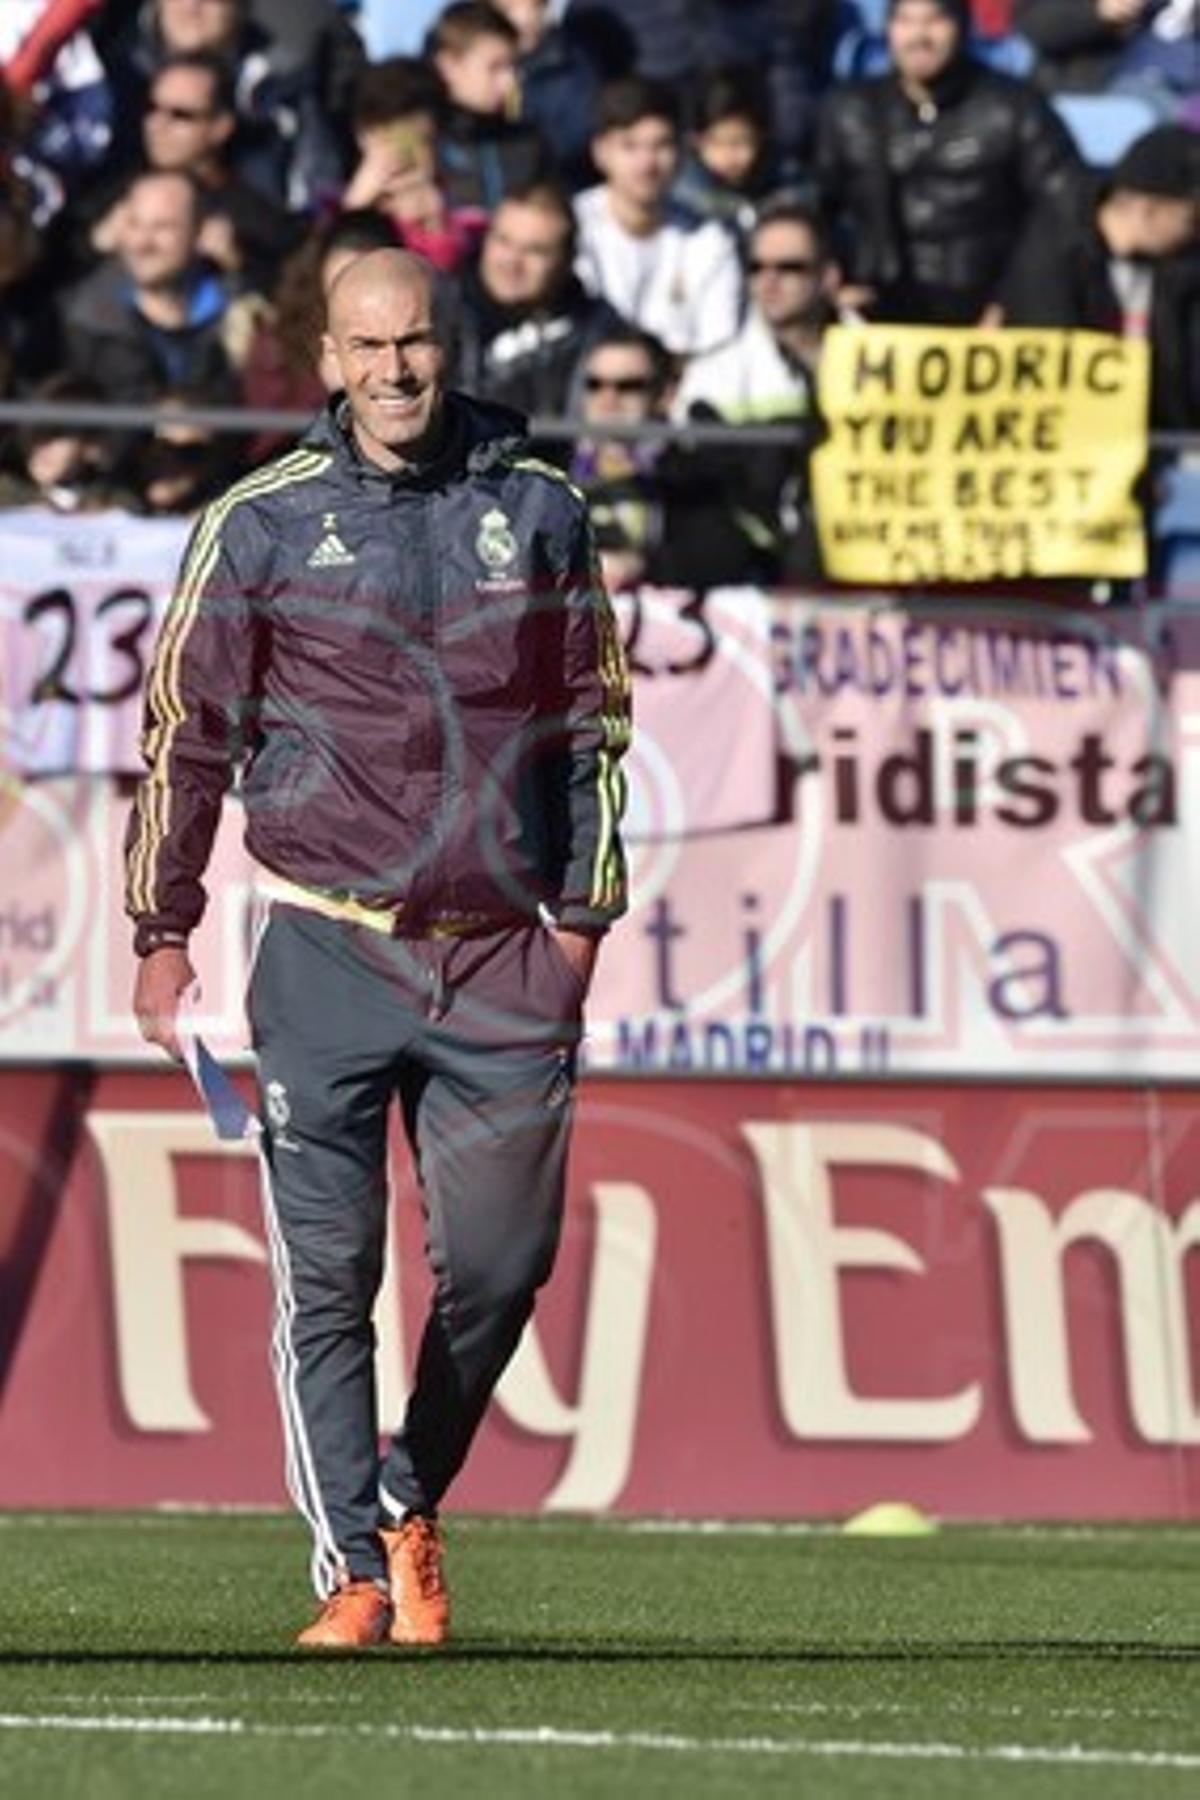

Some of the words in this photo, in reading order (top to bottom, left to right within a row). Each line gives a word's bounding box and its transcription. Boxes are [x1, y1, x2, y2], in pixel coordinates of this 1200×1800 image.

[843, 413, 933, 454] YOU
[954, 405, 1063, 454] ARE
[846, 468, 928, 507] THE
[954, 467, 1096, 508] BEST
[24, 586, 151, 704] 23
[774, 729, 1177, 828] ridista
[644, 893, 1070, 1022] tilla
